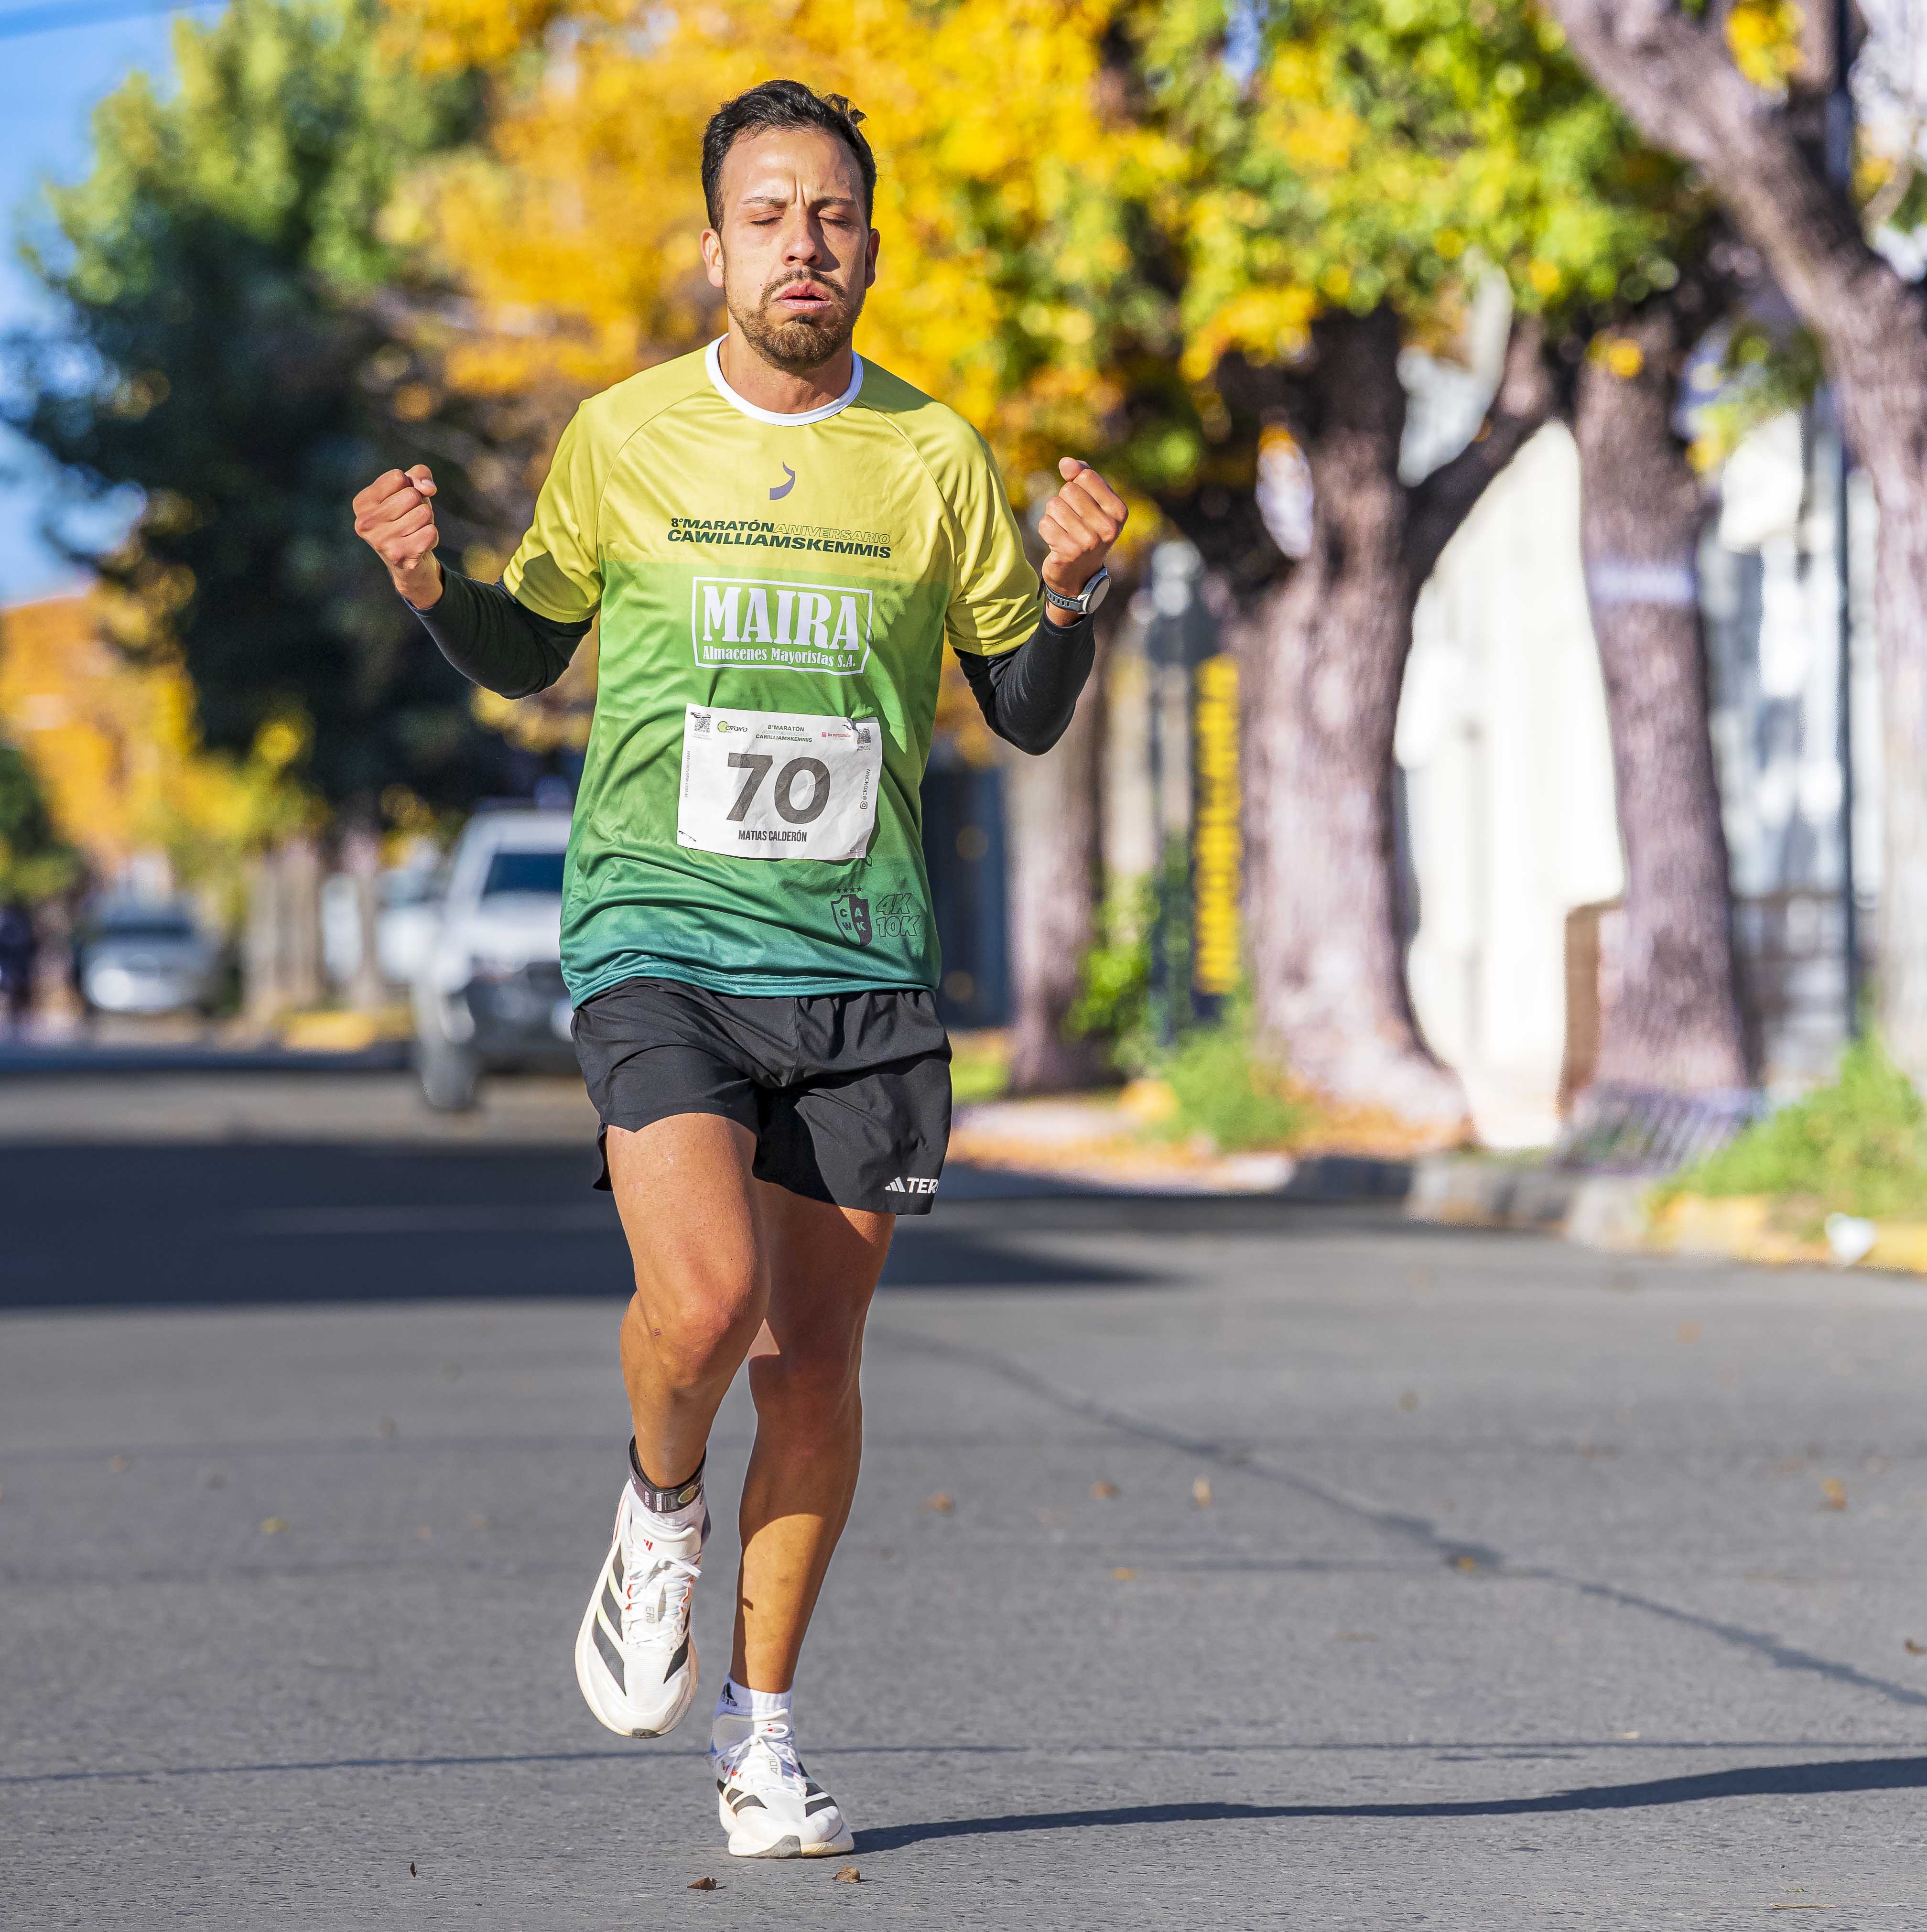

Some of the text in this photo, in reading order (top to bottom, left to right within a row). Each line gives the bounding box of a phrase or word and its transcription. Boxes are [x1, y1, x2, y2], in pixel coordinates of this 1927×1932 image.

[668, 529, 891, 558] CAWILLIAMSKEMMIS
[773, 523, 891, 545] ANIVERSARIO
[703, 585, 859, 650] MAIRA
[703, 646, 856, 668] Almacenes Mayoristas S.A.
[756, 734, 812, 742] CAWILLIAMSKEMMIS
[726, 752, 831, 824] 70
[862, 768, 871, 800] @CRONORAV
[738, 830, 807, 842] MATIAS CALDERÓN
[839, 907, 864, 918] C A
[876, 893, 912, 915] 4K
[876, 915, 921, 938] 10K
